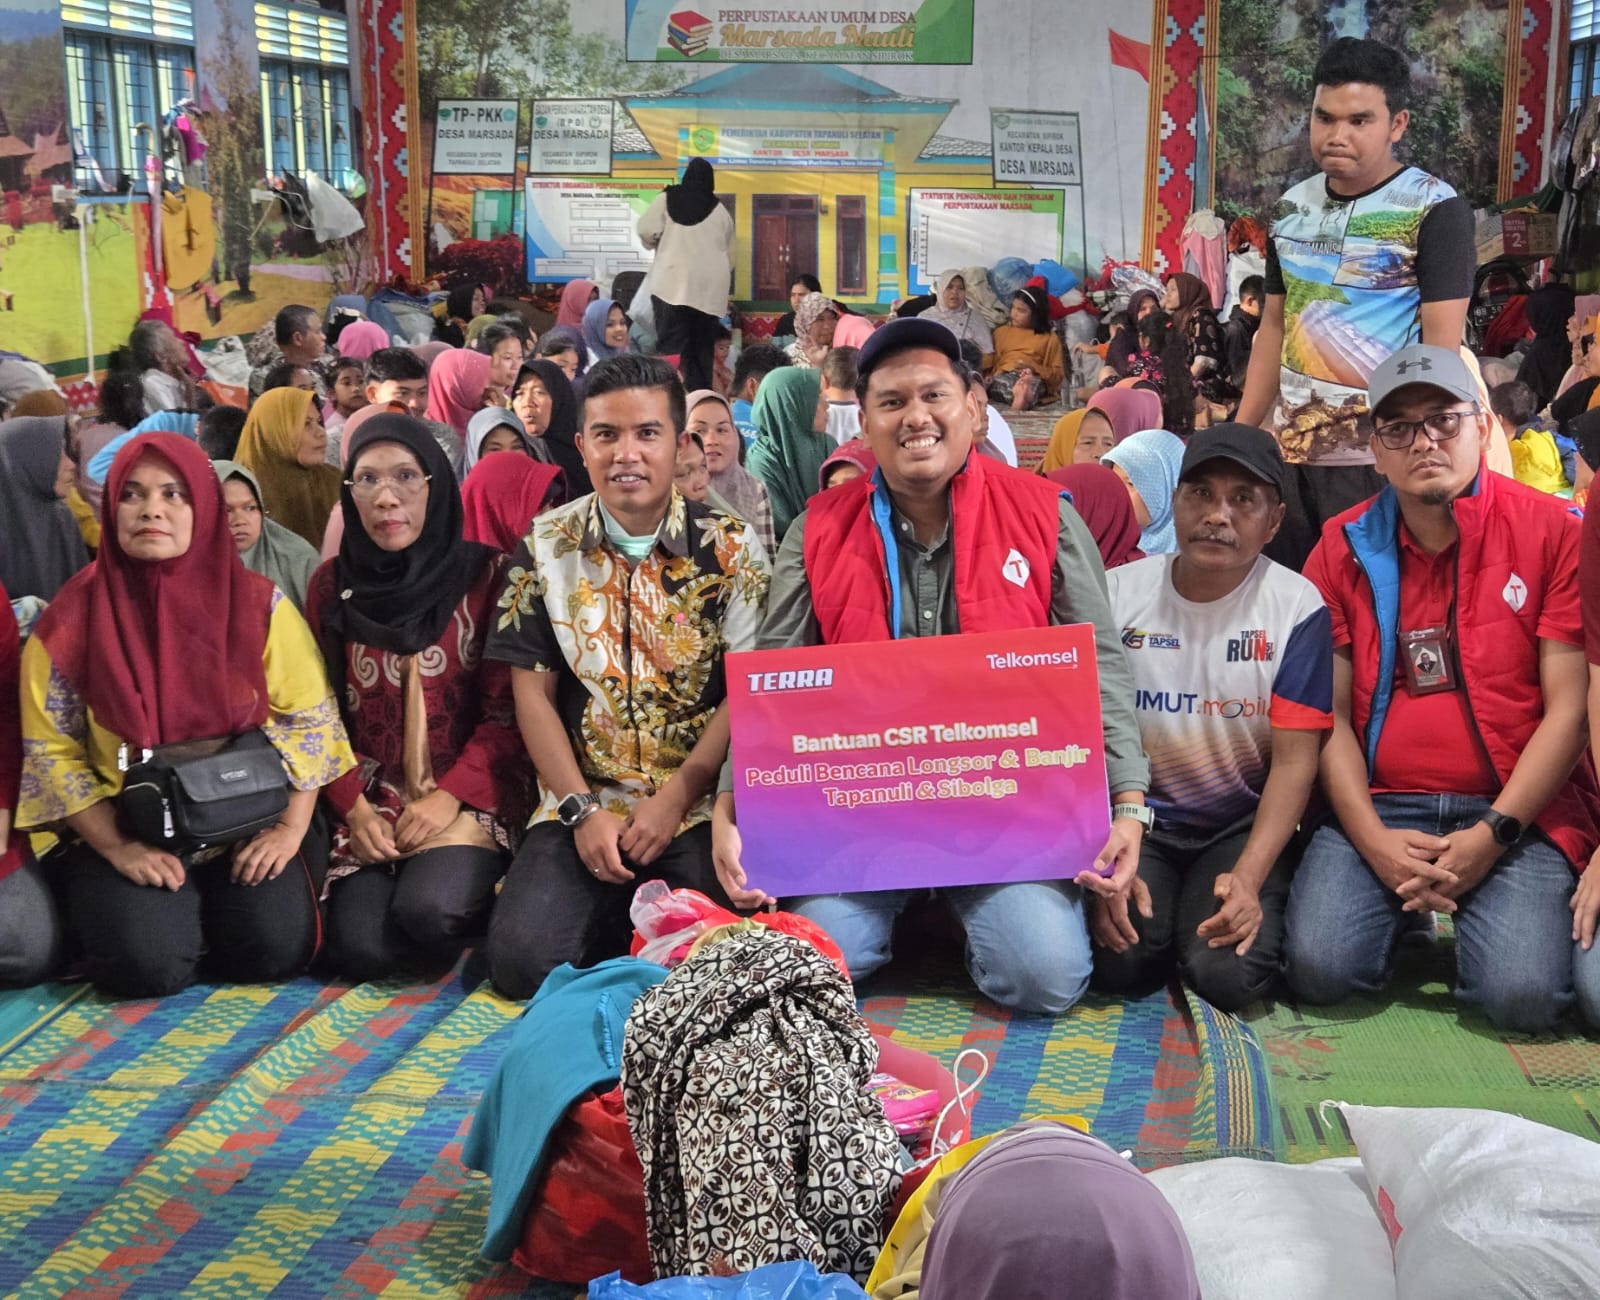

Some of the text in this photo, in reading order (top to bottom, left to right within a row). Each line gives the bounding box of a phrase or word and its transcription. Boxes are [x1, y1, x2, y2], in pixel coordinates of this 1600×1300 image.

[718, 10, 917, 24] PERPUSTAKAAN UMUM DESA
[720, 23, 914, 48] Marsada Nauli
[452, 107, 503, 122] TP-PKK
[438, 129, 514, 140] DESA MARSADA
[534, 130, 609, 140] DESA MARSADA
[1000, 142, 1073, 154] KANTOR KEPALA DESA
[1000, 159, 1076, 176] DESA MARSADA
[943, 202, 998, 210] PERPUSTAKAAN
[1512, 232, 1522, 248] 2
[1149, 637, 1180, 648] TAPSEL
[1240, 630, 1266, 639] TAPSEL
[986, 647, 1078, 669] Telkomsel
[1226, 639, 1267, 663] RUN
[747, 668, 834, 692] TERRA
[1136, 689, 1271, 719] MUT.mobil
[793, 717, 1038, 753] Bantuan CSR Telkomsel
[746, 745, 1091, 786] Peduli Bencana Longsor & Banjir
[823, 776, 1018, 808] Tapanuli & Sibolga
